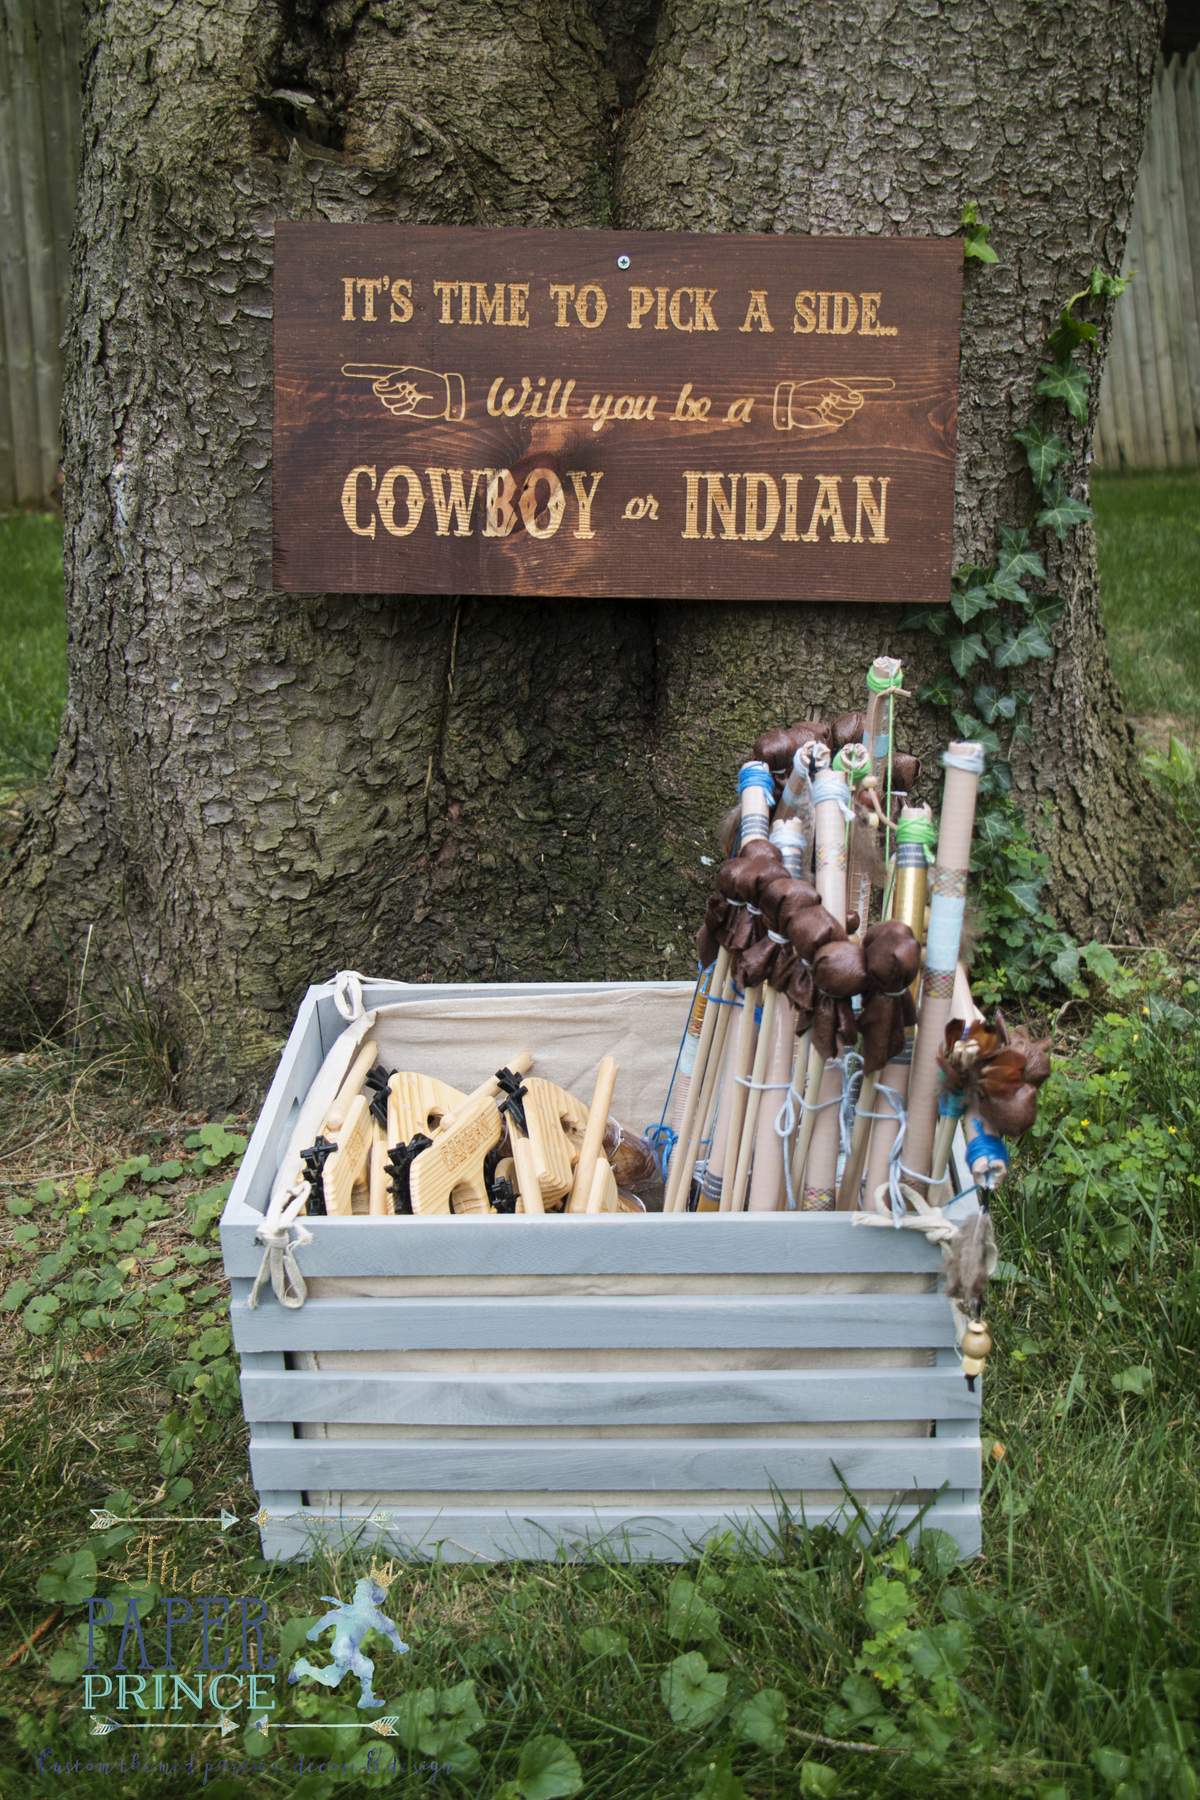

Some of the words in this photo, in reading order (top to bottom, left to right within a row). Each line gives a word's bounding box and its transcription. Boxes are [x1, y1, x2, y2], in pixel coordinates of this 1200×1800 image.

[341, 275, 414, 323] IT'S
[433, 279, 530, 328] TIME
[550, 283, 608, 328] TO
[627, 285, 720, 332] PICK
[738, 288, 774, 333] A
[487, 376, 576, 417] Will
[582, 393, 658, 432] you
[669, 382, 712, 422] be
[722, 397, 755, 423] a
[341, 464, 604, 540] COWBOY
[621, 493, 660, 521] or
[681, 470, 891, 544] INDIAN
